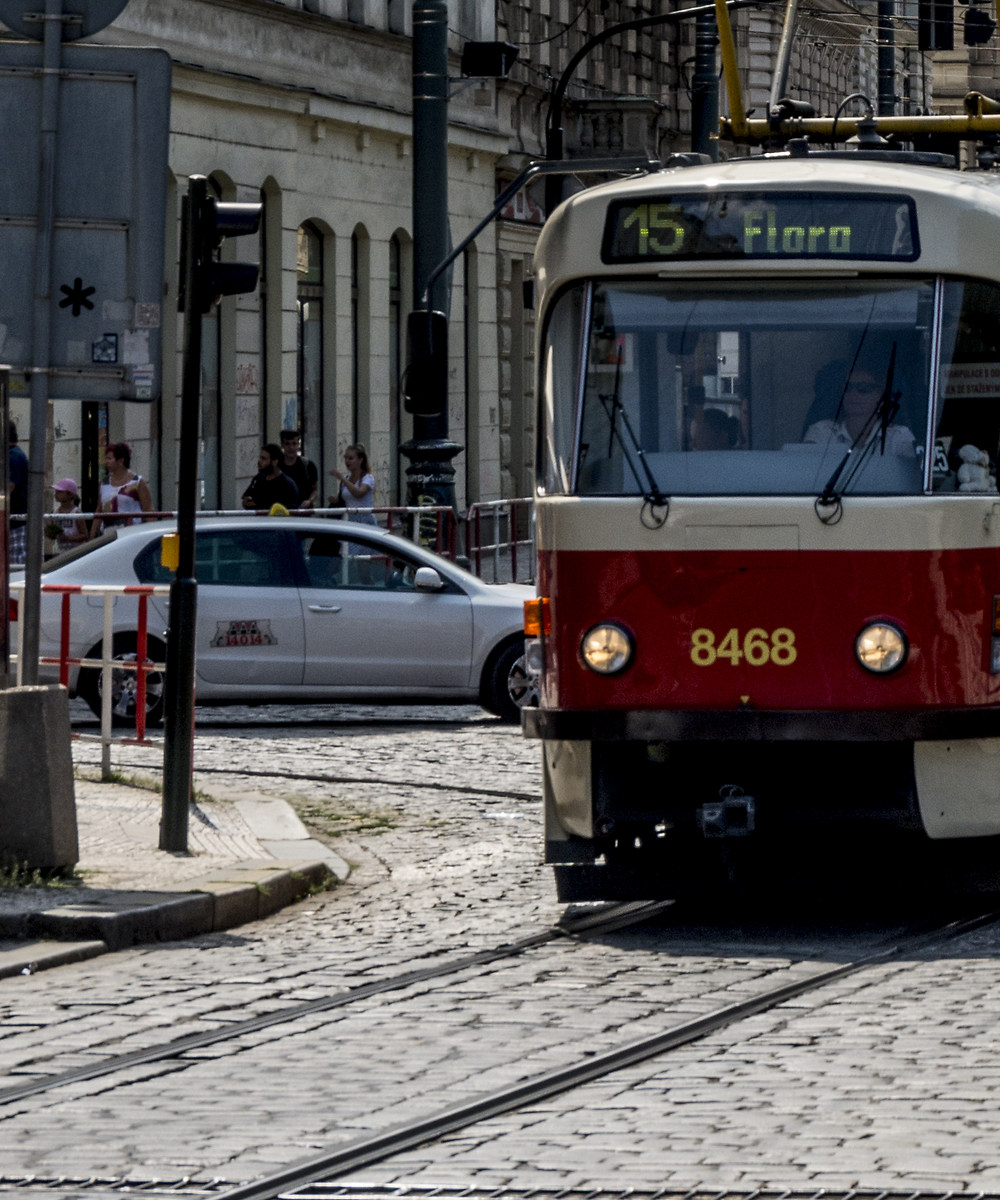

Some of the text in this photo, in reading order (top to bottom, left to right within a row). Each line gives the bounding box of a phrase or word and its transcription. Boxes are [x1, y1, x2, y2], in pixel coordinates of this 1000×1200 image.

[624, 203, 851, 255] 15 Flora
[691, 628, 797, 666] 8468
